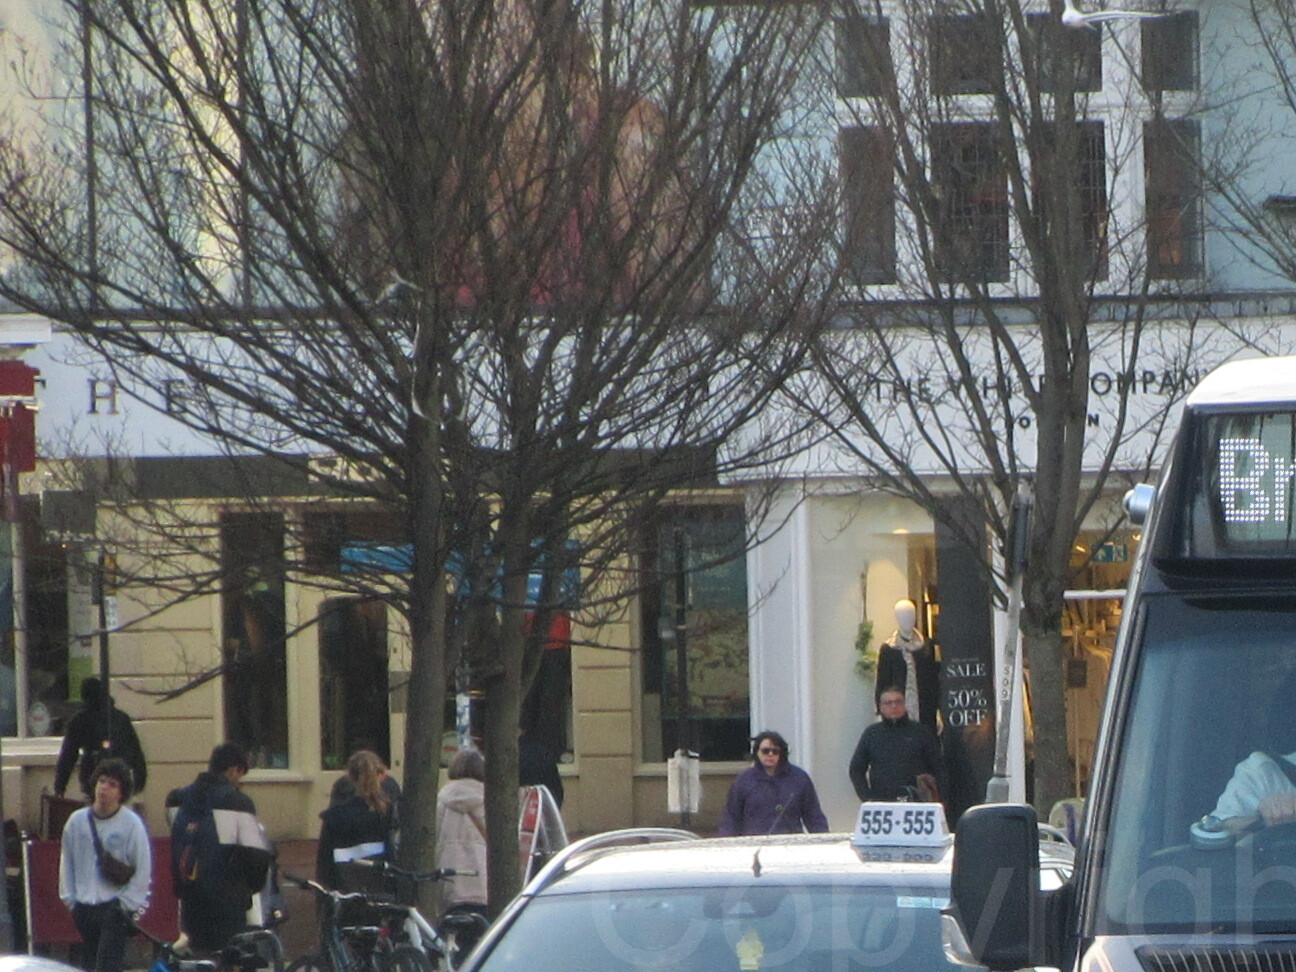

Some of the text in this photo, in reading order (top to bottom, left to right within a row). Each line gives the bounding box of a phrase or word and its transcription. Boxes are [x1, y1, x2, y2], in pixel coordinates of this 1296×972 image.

[1090, 367, 1208, 396] OMPAN
[946, 662, 987, 678] SALE
[947, 688, 988, 709] 50%
[949, 708, 988, 728] OFF
